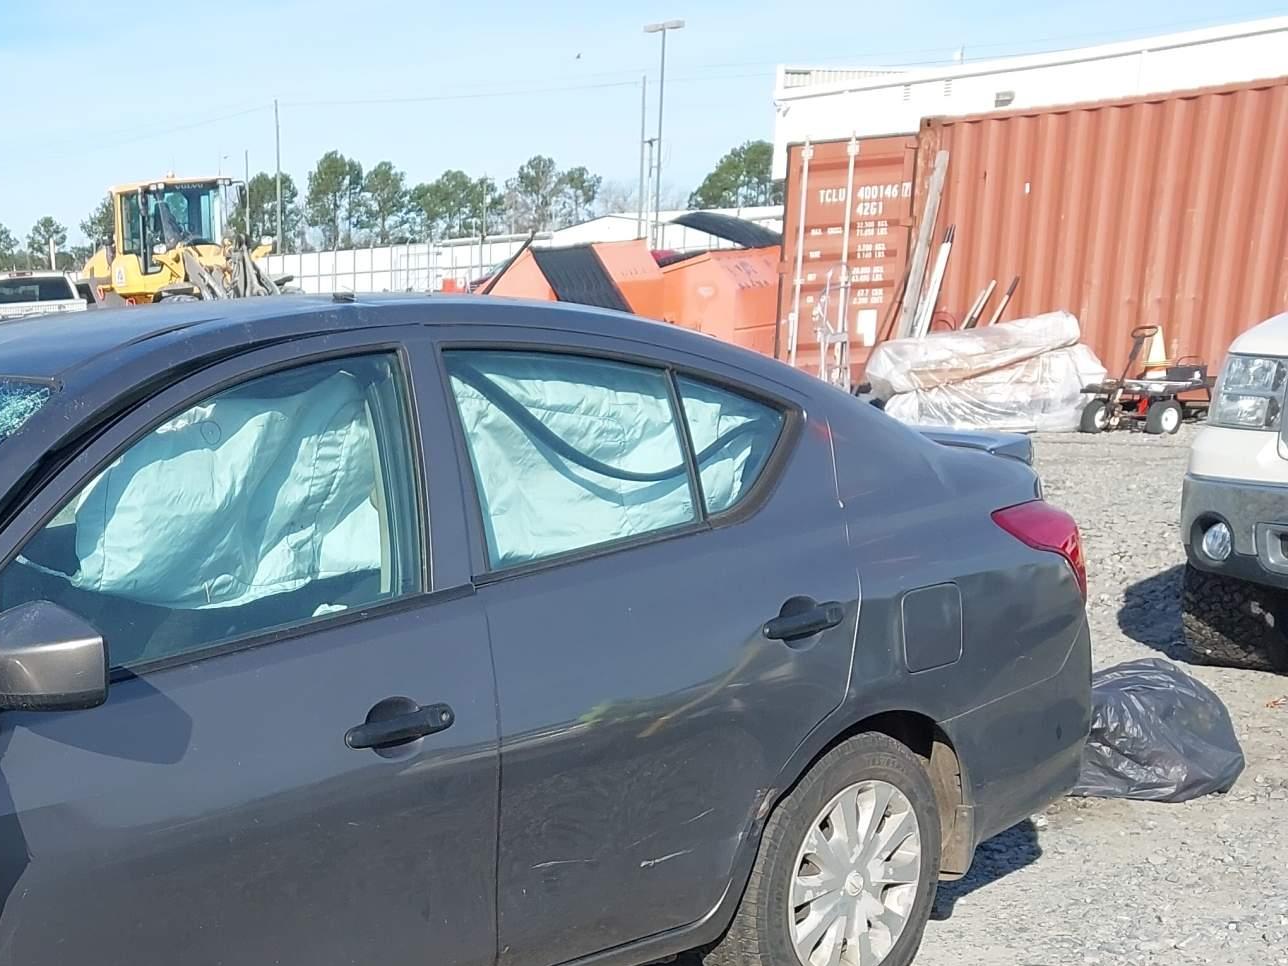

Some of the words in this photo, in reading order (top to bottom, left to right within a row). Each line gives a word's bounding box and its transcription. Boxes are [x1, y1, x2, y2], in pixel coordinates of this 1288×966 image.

[819, 187, 846, 203] TCLU
[857, 184, 899, 200] 400146
[856, 202, 883, 216] 42G1
